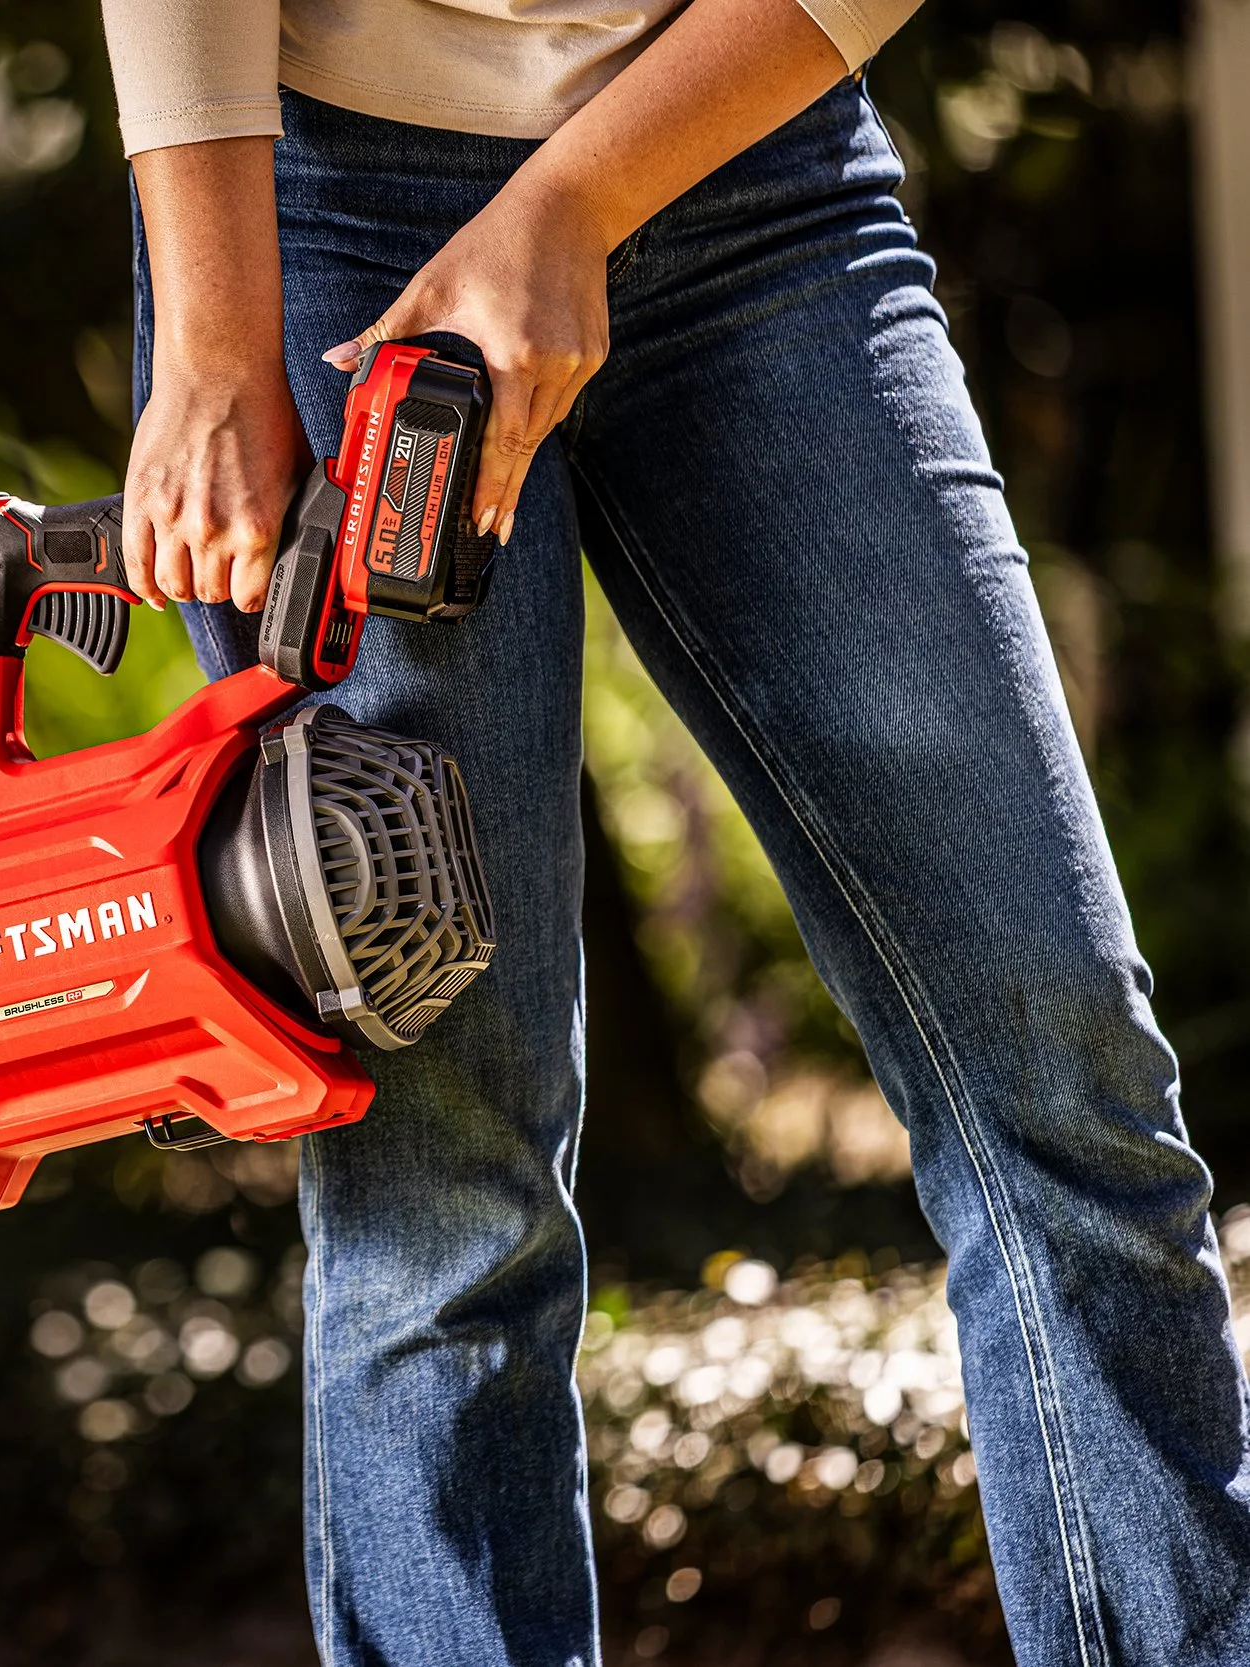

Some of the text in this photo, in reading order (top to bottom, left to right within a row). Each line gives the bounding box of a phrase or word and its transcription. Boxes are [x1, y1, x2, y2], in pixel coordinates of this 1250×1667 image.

[344, 411, 381, 545] CRAFTSMAN
[423, 441, 450, 541] LITHIUM ION
[375, 517, 399, 565] 5.0 AH
[4, 995, 65, 1017] BRUSHLESS
